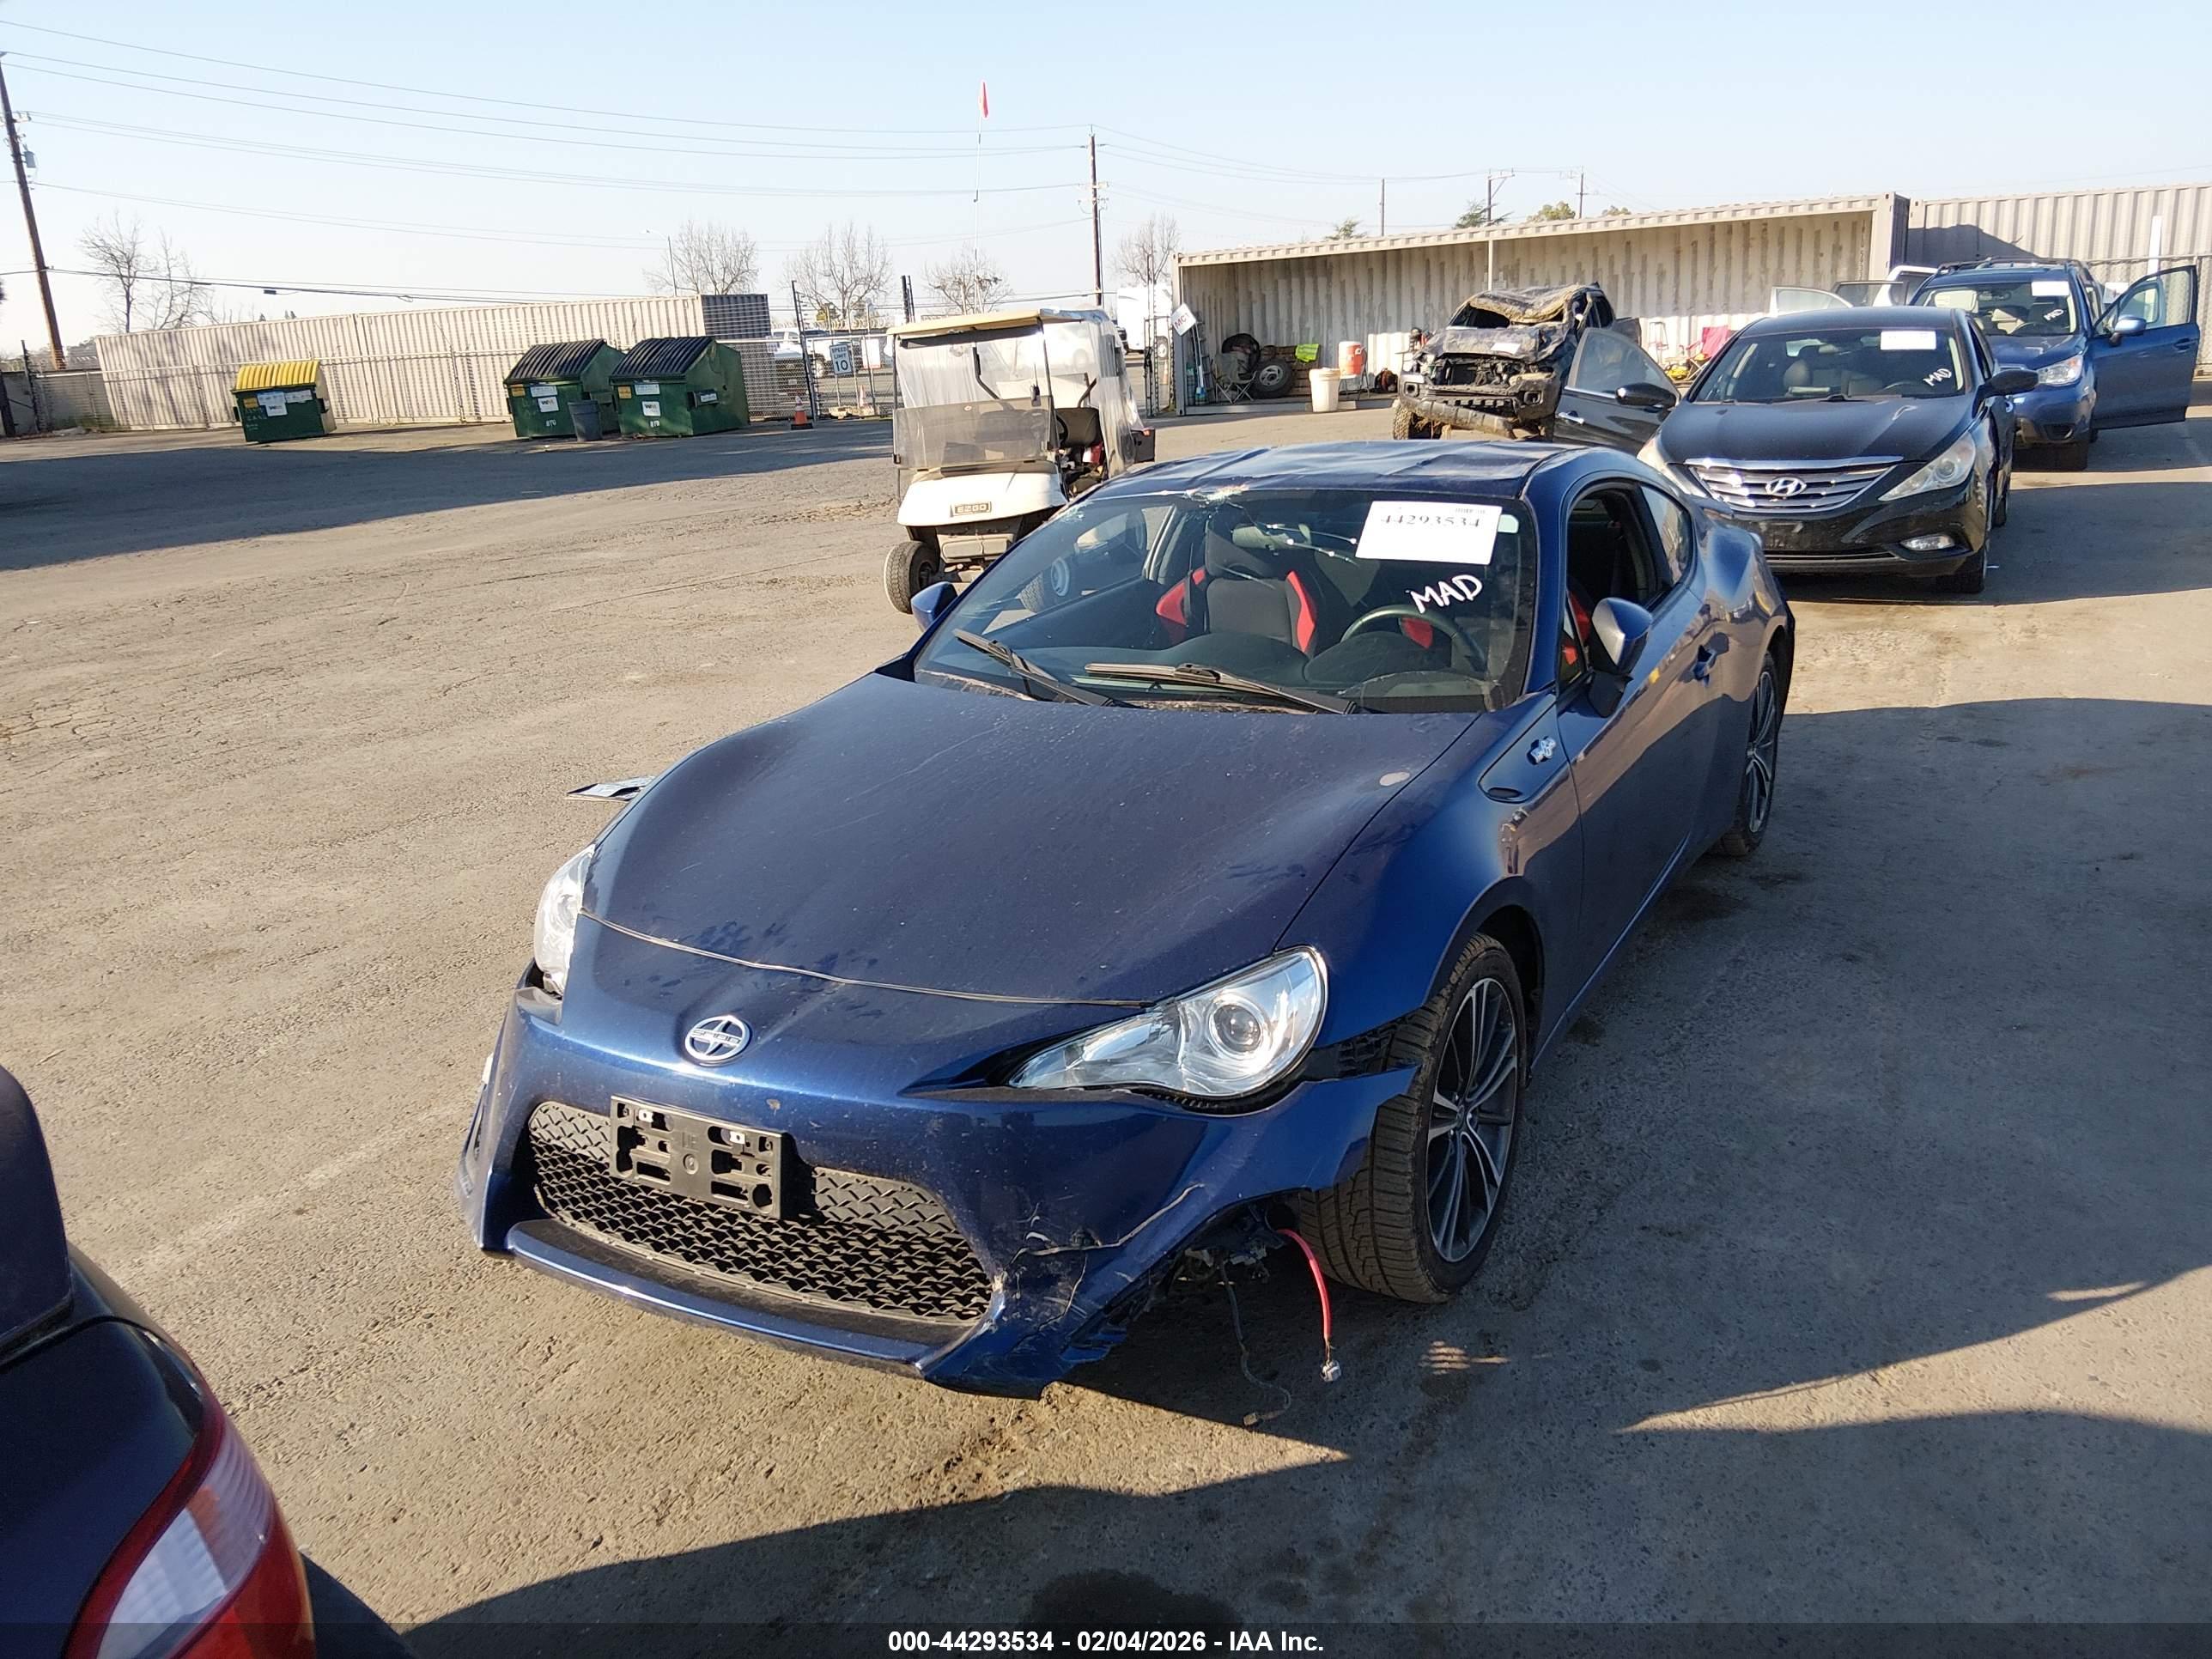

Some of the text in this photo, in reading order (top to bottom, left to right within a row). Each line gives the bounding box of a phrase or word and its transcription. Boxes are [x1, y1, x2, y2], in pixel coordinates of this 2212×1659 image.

[835, 359, 848, 372] 10
[1923, 368, 1953, 387] MAD
[1380, 514, 1481, 528] 44293534
[1406, 574, 1483, 614] MAD
